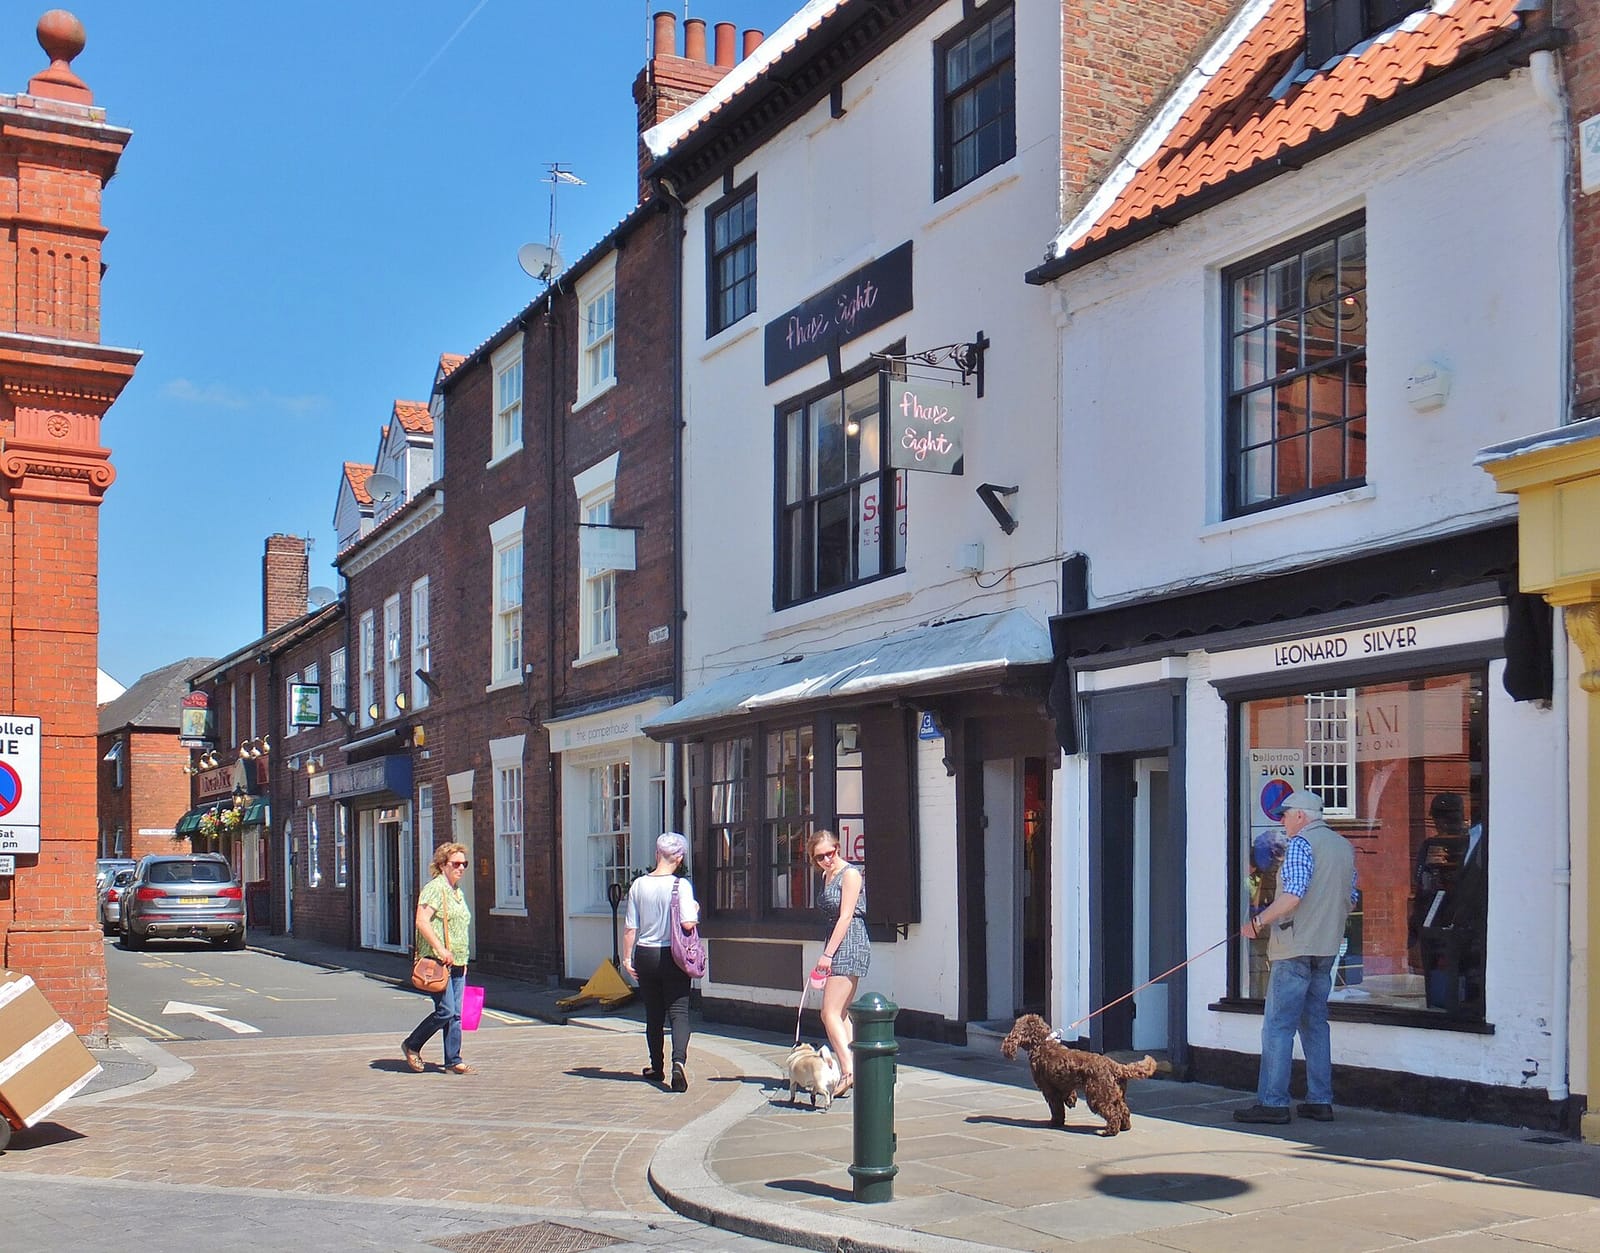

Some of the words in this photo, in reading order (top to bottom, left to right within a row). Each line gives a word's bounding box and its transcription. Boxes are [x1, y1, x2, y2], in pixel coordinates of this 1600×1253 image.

[786, 315, 829, 350] Phase
[834, 280, 878, 334] Eight
[899, 391, 955, 424] Phase
[901, 426, 952, 461] Eight
[1275, 637, 1348, 666] LEONARD
[1363, 626, 1417, 653] SILVER
